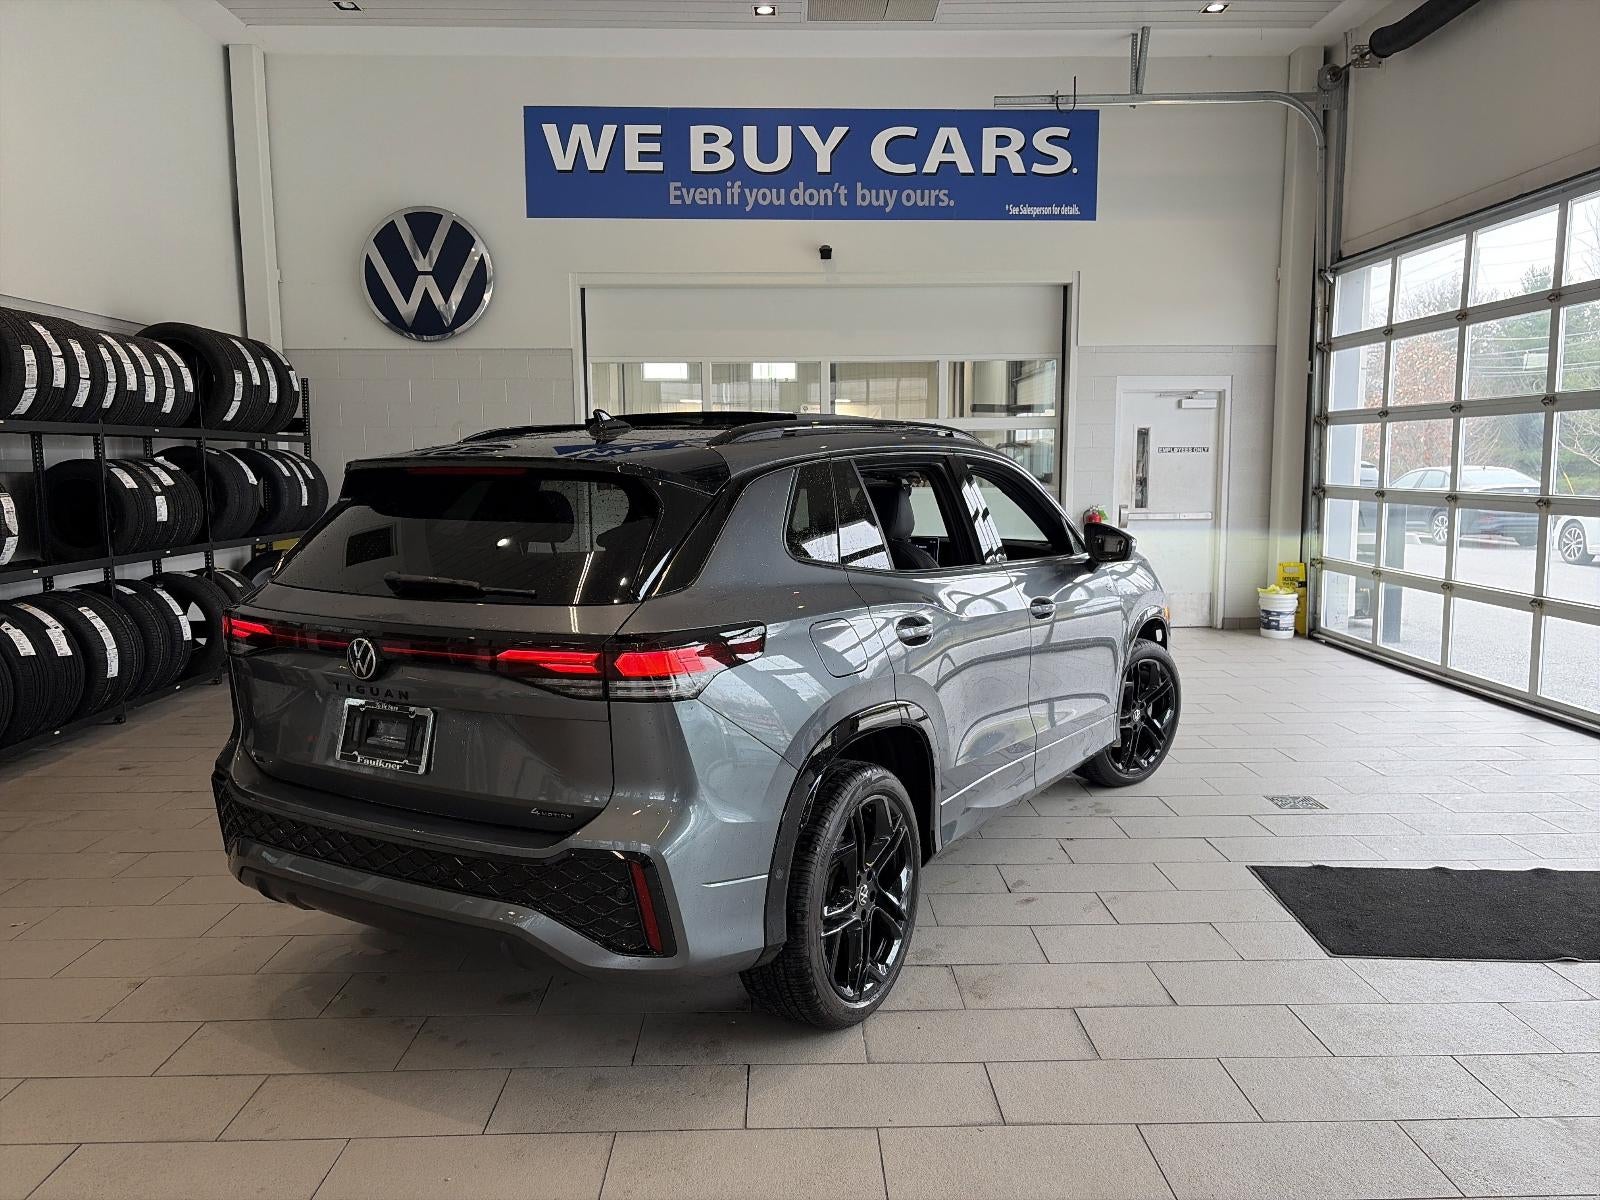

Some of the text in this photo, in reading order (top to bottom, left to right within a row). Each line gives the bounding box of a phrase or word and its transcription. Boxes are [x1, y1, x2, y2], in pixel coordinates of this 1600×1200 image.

[541, 123, 1079, 175] WE BUY CARS.
[669, 181, 955, 212] Even if you don’t buy ours.
[1020, 204, 1051, 218] Salesperson
[1052, 204, 1061, 215] for
[1061, 204, 1081, 215] details.
[333, 682, 409, 700] TIGUAN
[358, 756, 403, 770] Faulkner
